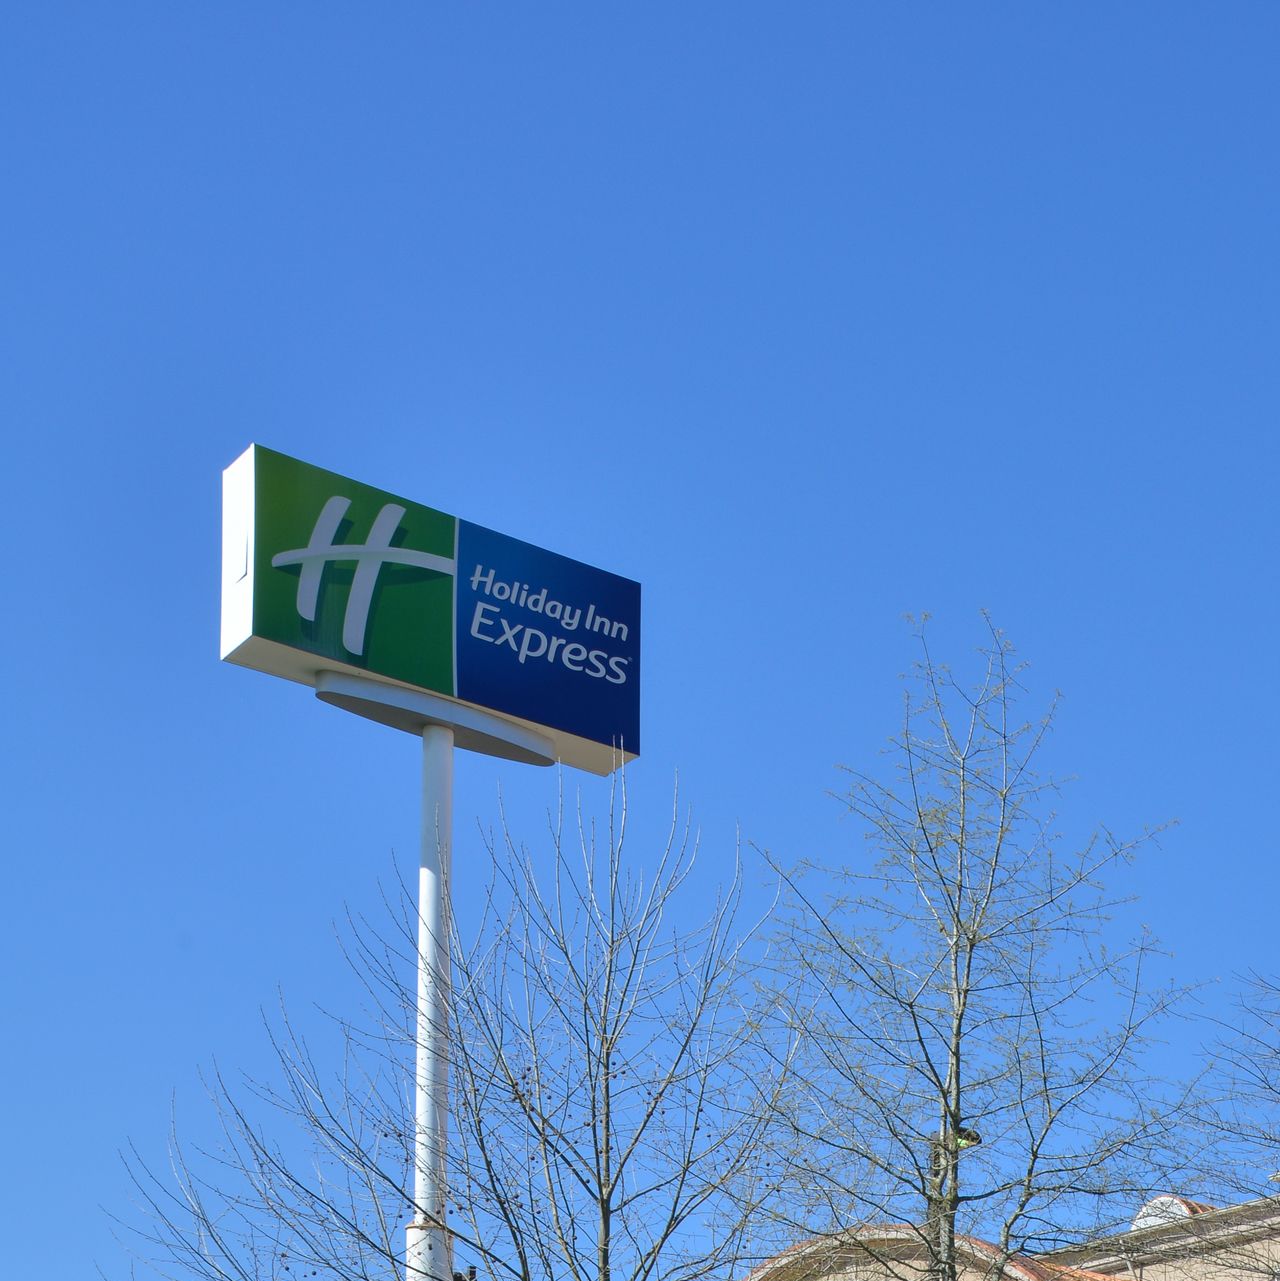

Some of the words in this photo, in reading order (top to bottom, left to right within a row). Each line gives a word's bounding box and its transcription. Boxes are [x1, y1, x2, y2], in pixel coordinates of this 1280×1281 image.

[470, 564, 581, 631] Holiday
[585, 604, 629, 642] Inn
[470, 601, 629, 685] Express
